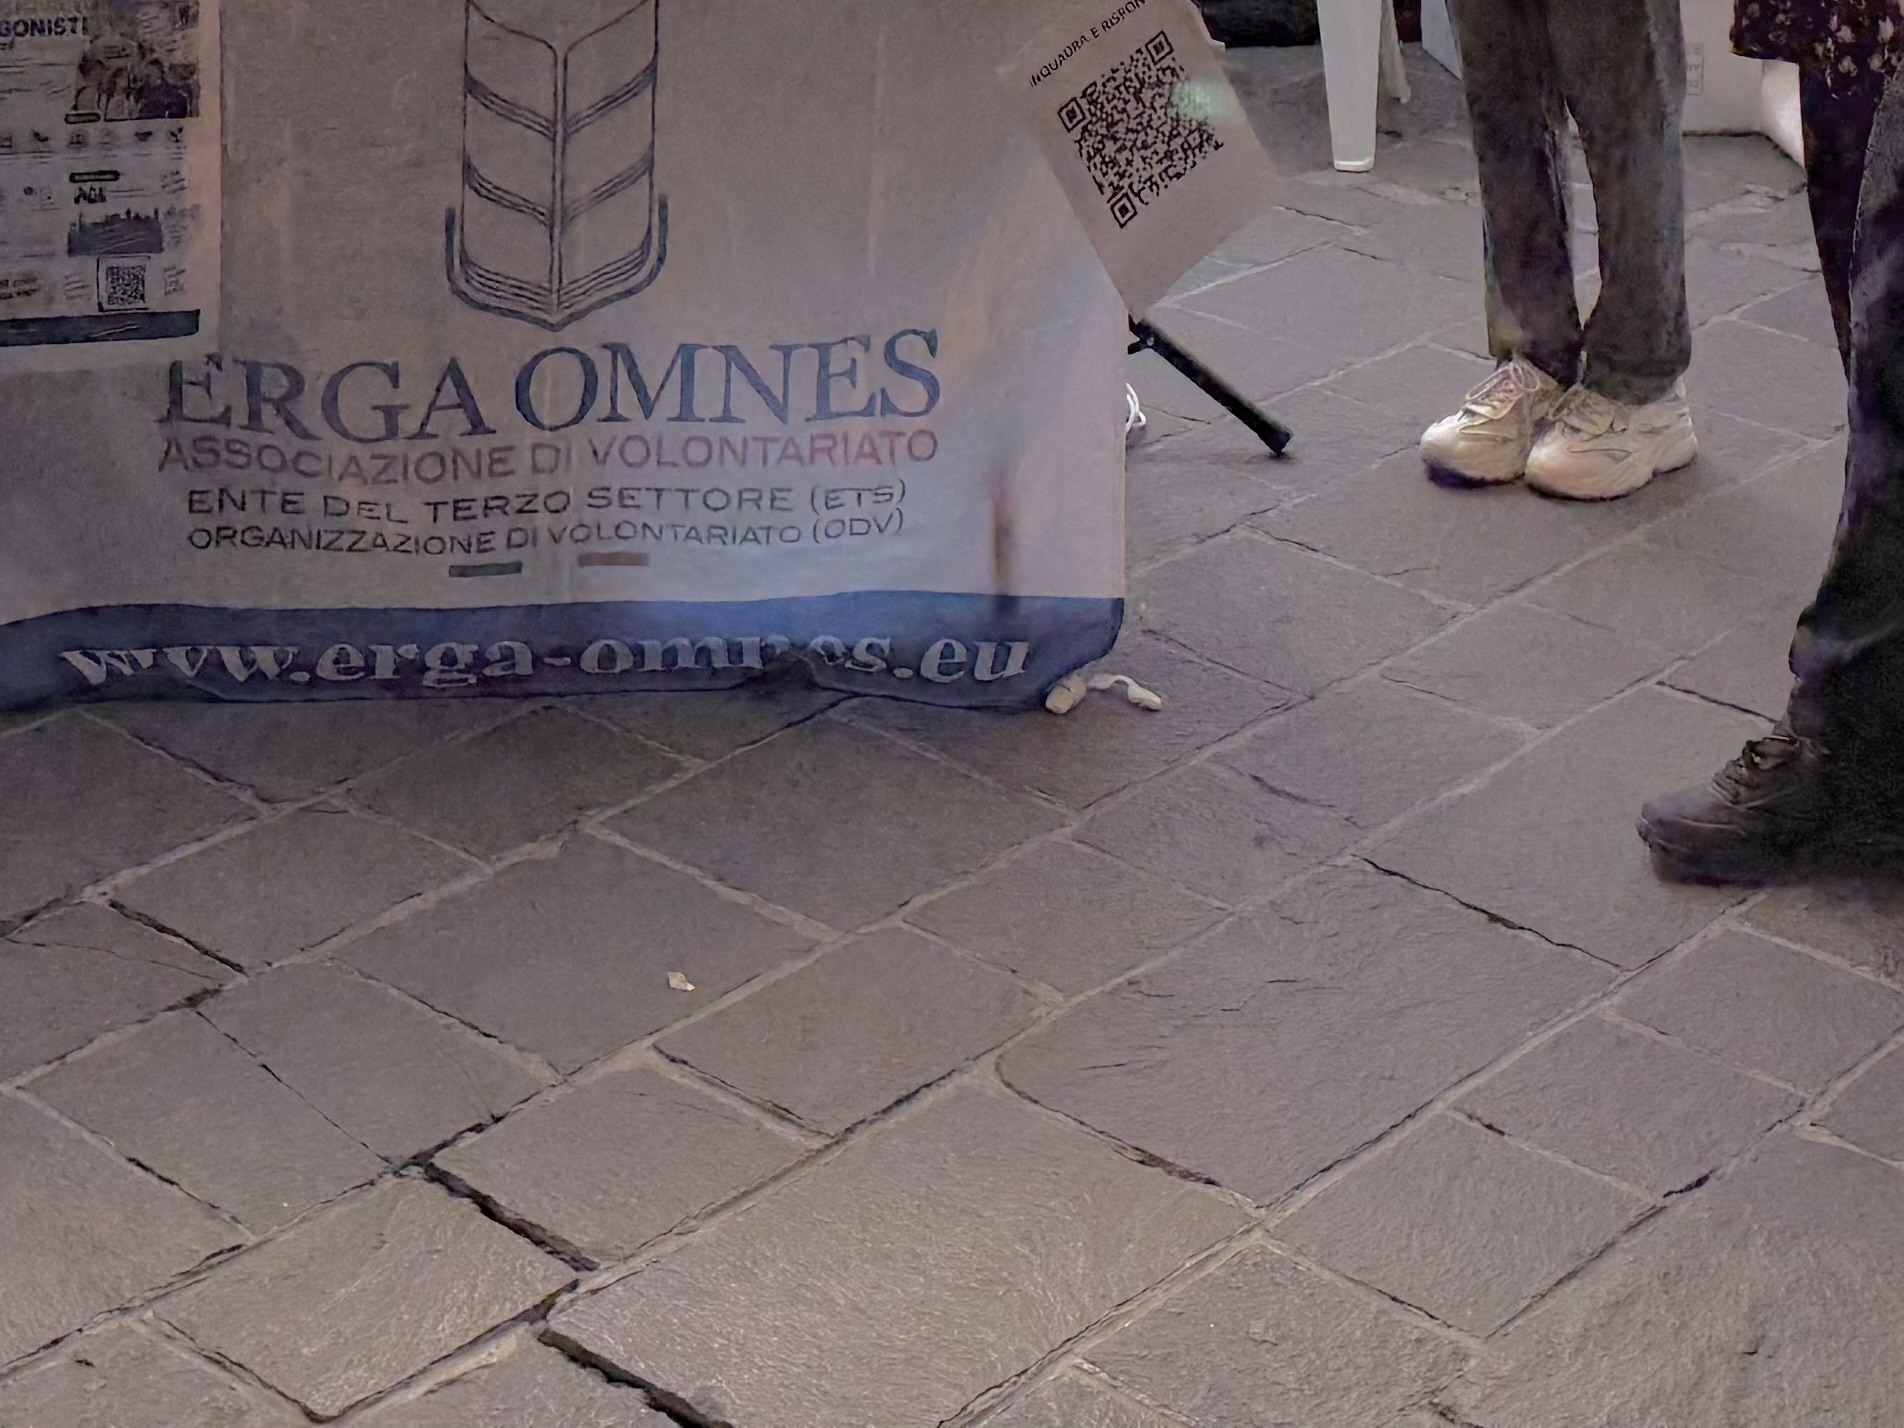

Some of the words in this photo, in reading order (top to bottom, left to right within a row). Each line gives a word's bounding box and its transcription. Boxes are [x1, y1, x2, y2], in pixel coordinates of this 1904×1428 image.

[156, 353, 497, 444] ERGA
[515, 329, 941, 431] OMNES
[158, 436, 515, 485] ASSOCIAZIONE
[532, 442, 573, 476] DI
[593, 429, 938, 469] VOLONTARIATO
[188, 488, 305, 515] ENTE
[323, 495, 408, 524] DEL
[426, 490, 571, 522] TERZO
[587, 487, 794, 512] SETTORE
[811, 479, 906, 511] (ETS)
[188, 526, 497, 555] ORGANIZZAZIONE
[506, 526, 538, 549] DI
[550, 521, 801, 545] VOLONTARIATO
[812, 507, 903, 544] (ODV)
